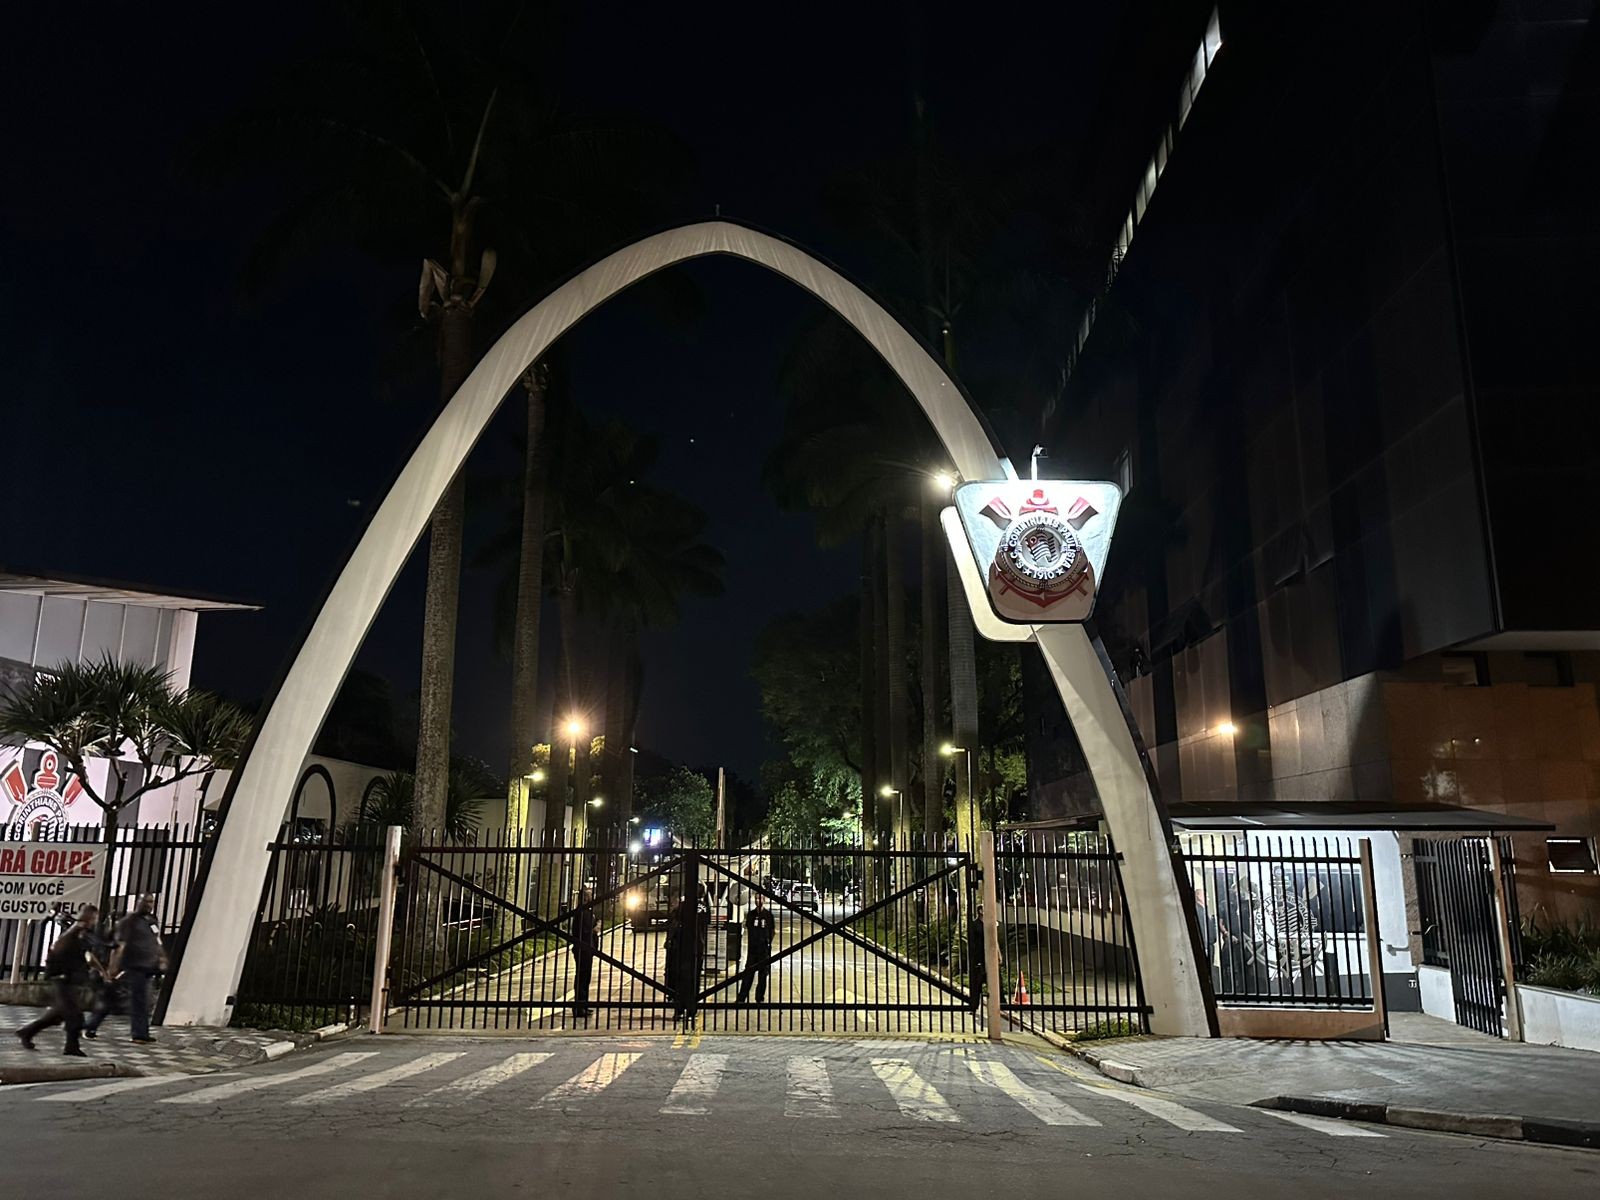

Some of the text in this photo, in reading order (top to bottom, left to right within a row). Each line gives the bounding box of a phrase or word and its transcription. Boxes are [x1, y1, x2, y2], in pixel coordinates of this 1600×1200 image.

[1061, 526, 1078, 569] PAULISTA
[1033, 570, 1056, 580] 1910
[0, 845, 96, 875] RÁ GOLPE.
[29, 880, 65, 895] VOCÊ
[0, 900, 47, 914] GUSTO
